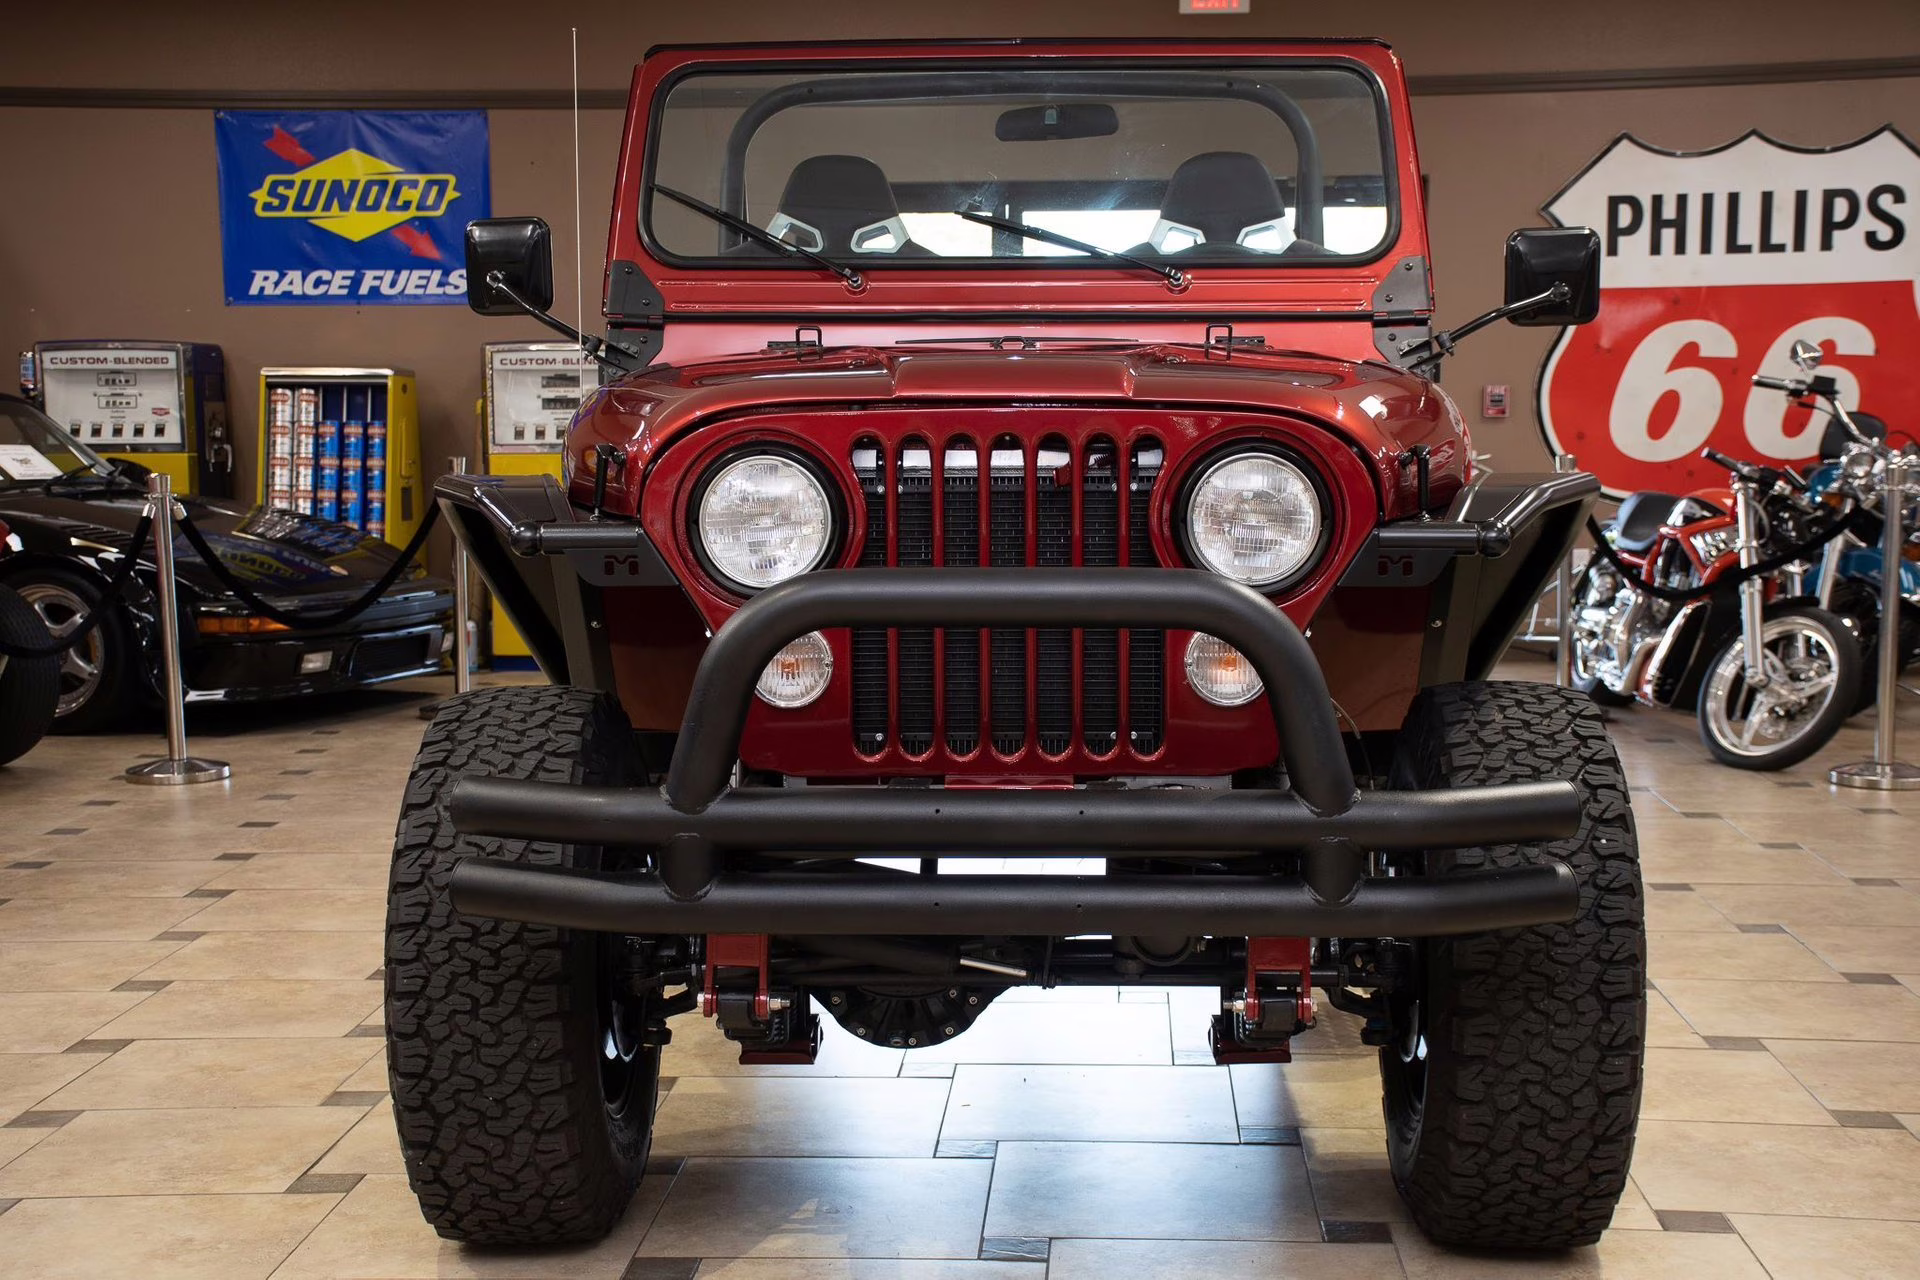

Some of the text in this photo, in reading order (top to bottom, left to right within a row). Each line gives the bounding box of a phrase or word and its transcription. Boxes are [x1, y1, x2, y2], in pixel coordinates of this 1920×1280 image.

[261, 178, 451, 213] SUNOCO
[1605, 184, 1908, 257] PHILLIPS
[248, 268, 468, 296] RACE FUELS
[1609, 316, 1876, 463] 66
